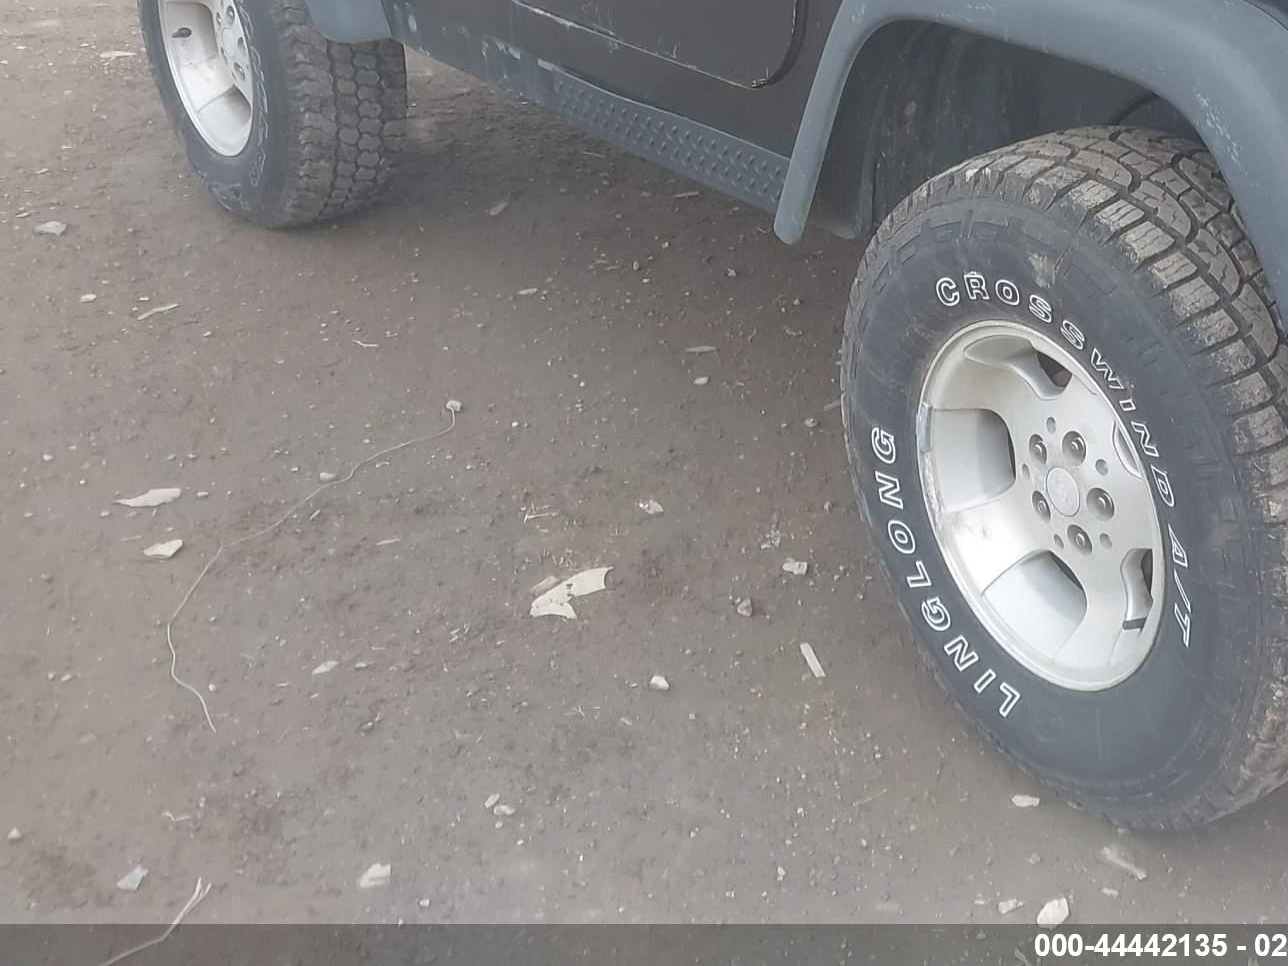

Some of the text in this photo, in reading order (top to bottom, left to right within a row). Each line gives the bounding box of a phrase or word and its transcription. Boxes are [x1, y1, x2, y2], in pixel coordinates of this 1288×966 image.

[871, 425, 1020, 718] LINGLONG
[935, 272, 1191, 648] CROSSWIND A/T
